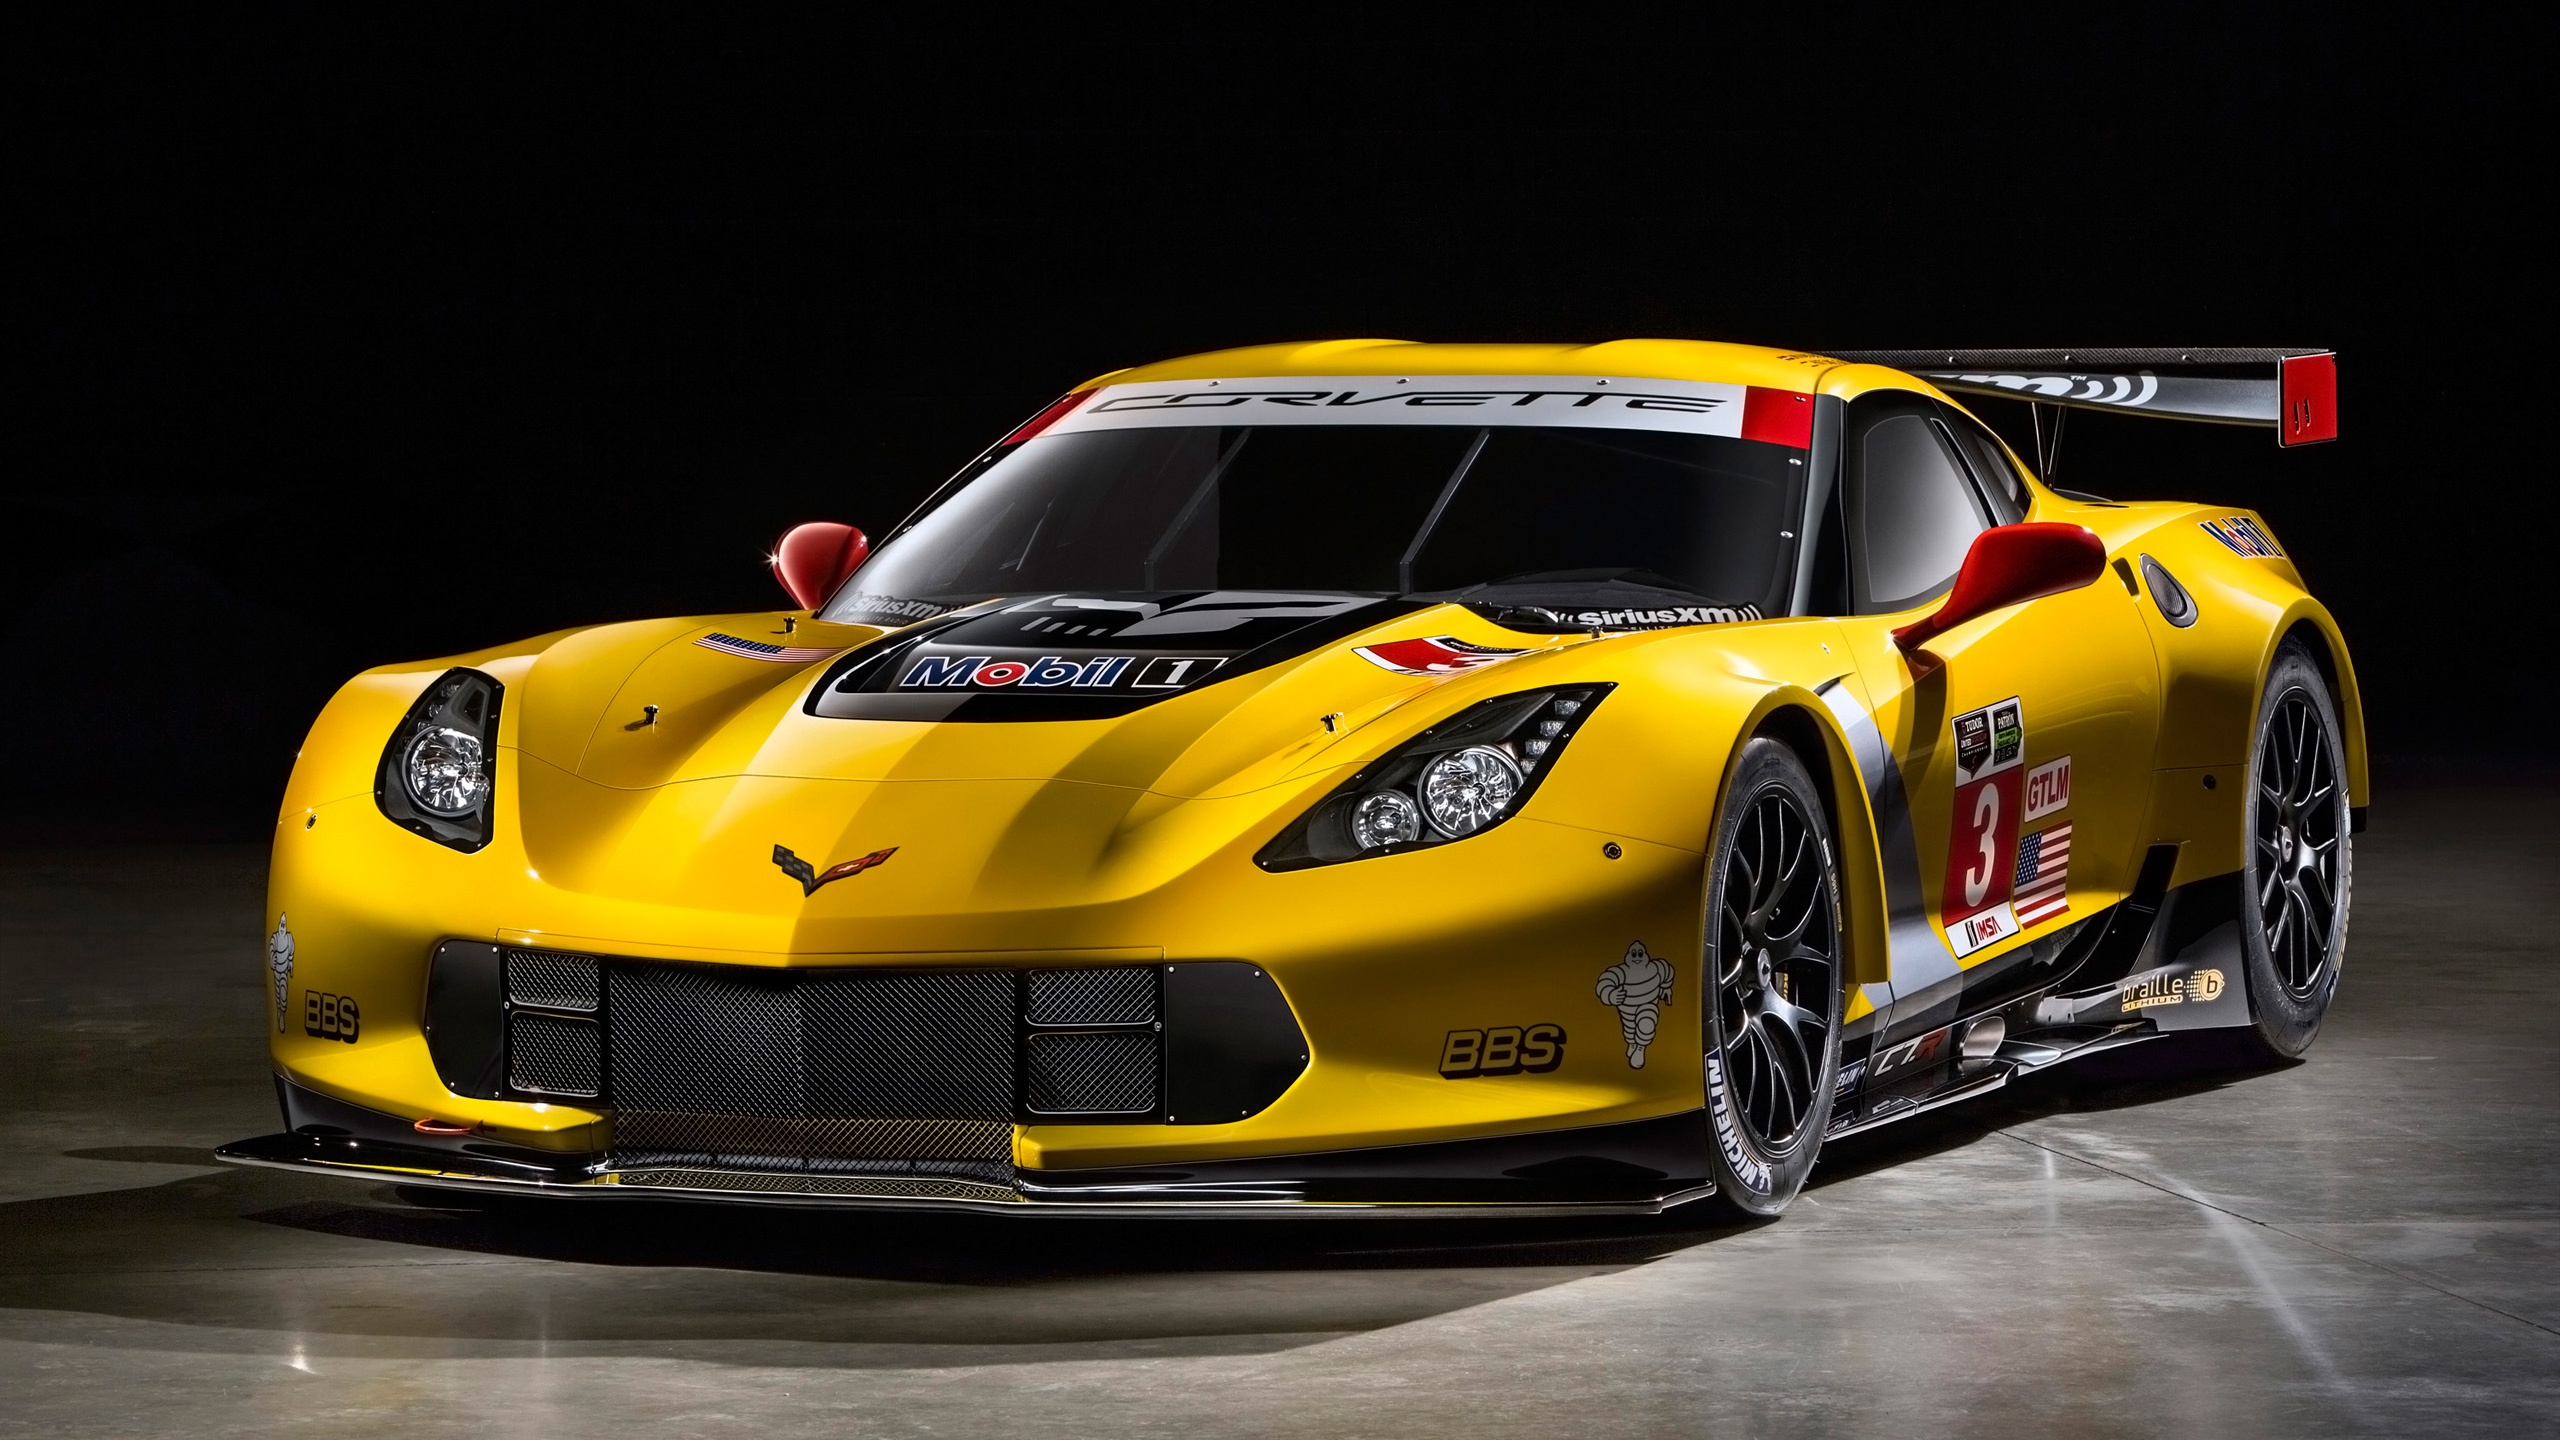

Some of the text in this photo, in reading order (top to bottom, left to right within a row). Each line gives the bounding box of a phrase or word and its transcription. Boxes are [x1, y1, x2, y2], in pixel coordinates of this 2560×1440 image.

[1086, 391, 1728, 414] CORVETTE
[2197, 516, 2276, 560] Mobil
[899, 656, 1195, 687] Mobil 1
[1965, 716, 1983, 733] TUDOR
[2027, 764, 2070, 813] GTLM
[1965, 782, 2000, 907] 3
[1975, 915, 2003, 941] IMSA
[2122, 974, 2183, 1002] braille
[2122, 996, 2182, 1011] LITHIUM
[304, 989, 360, 1044] BBS
[1438, 1023, 1567, 1080] BBS
[1708, 1059, 1759, 1185] MICHELIN
